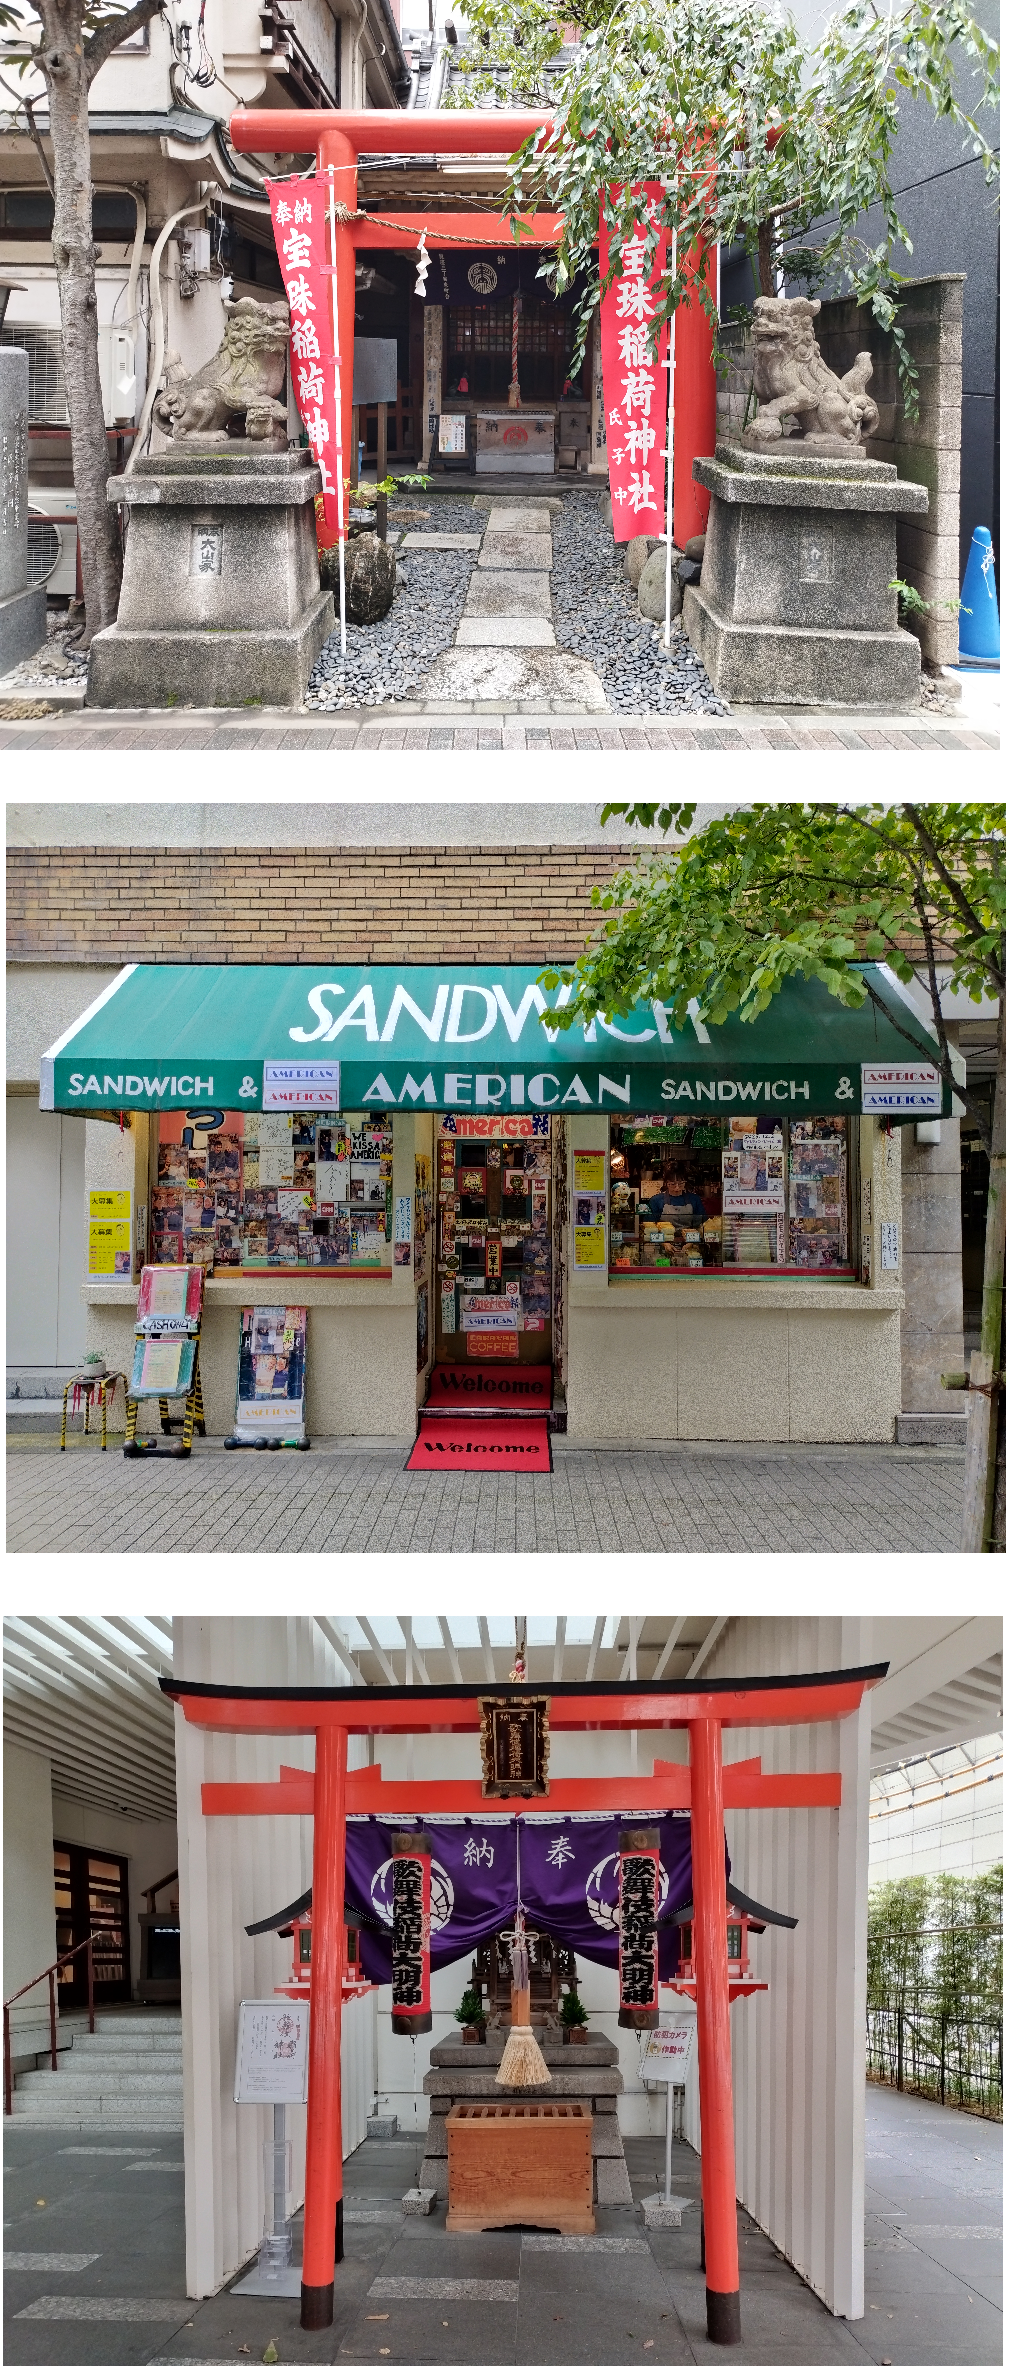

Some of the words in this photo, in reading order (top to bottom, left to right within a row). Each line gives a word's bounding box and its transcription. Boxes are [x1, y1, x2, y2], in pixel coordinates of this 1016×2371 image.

[275, 197, 312, 227] 奉納
[616, 234, 658, 514] 宝珠稲荷神社
[608, 408, 628, 506] 氏子中
[269, 1069, 334, 1078] AMERICAN
[868, 1072, 935, 1082] AMERICAN
[68, 1073, 214, 1097] SANDWICH
[238, 1076, 258, 1098] &
[362, 1072, 631, 1106] AMERICAN
[660, 1078, 810, 1101] SANDWICH
[834, 1076, 854, 1099] &
[269, 1092, 334, 1101] AMERICAN
[868, 1096, 936, 1105] AMERICAN
[487, 1243, 499, 1276] 営業中
[143, 1320, 169, 1331] CASH
[468, 1317, 513, 1325] AMERICAN
[469, 1342, 517, 1352] COFFEE
[439, 1372, 544, 1394] Welcome
[424, 1442, 540, 1454] Welcome
[463, 1837, 495, 1869] 納
[545, 1835, 576, 1870] 奉
[653, 2030, 688, 2040] 防犯カメラ
[661, 2045, 685, 2055] 作動中
